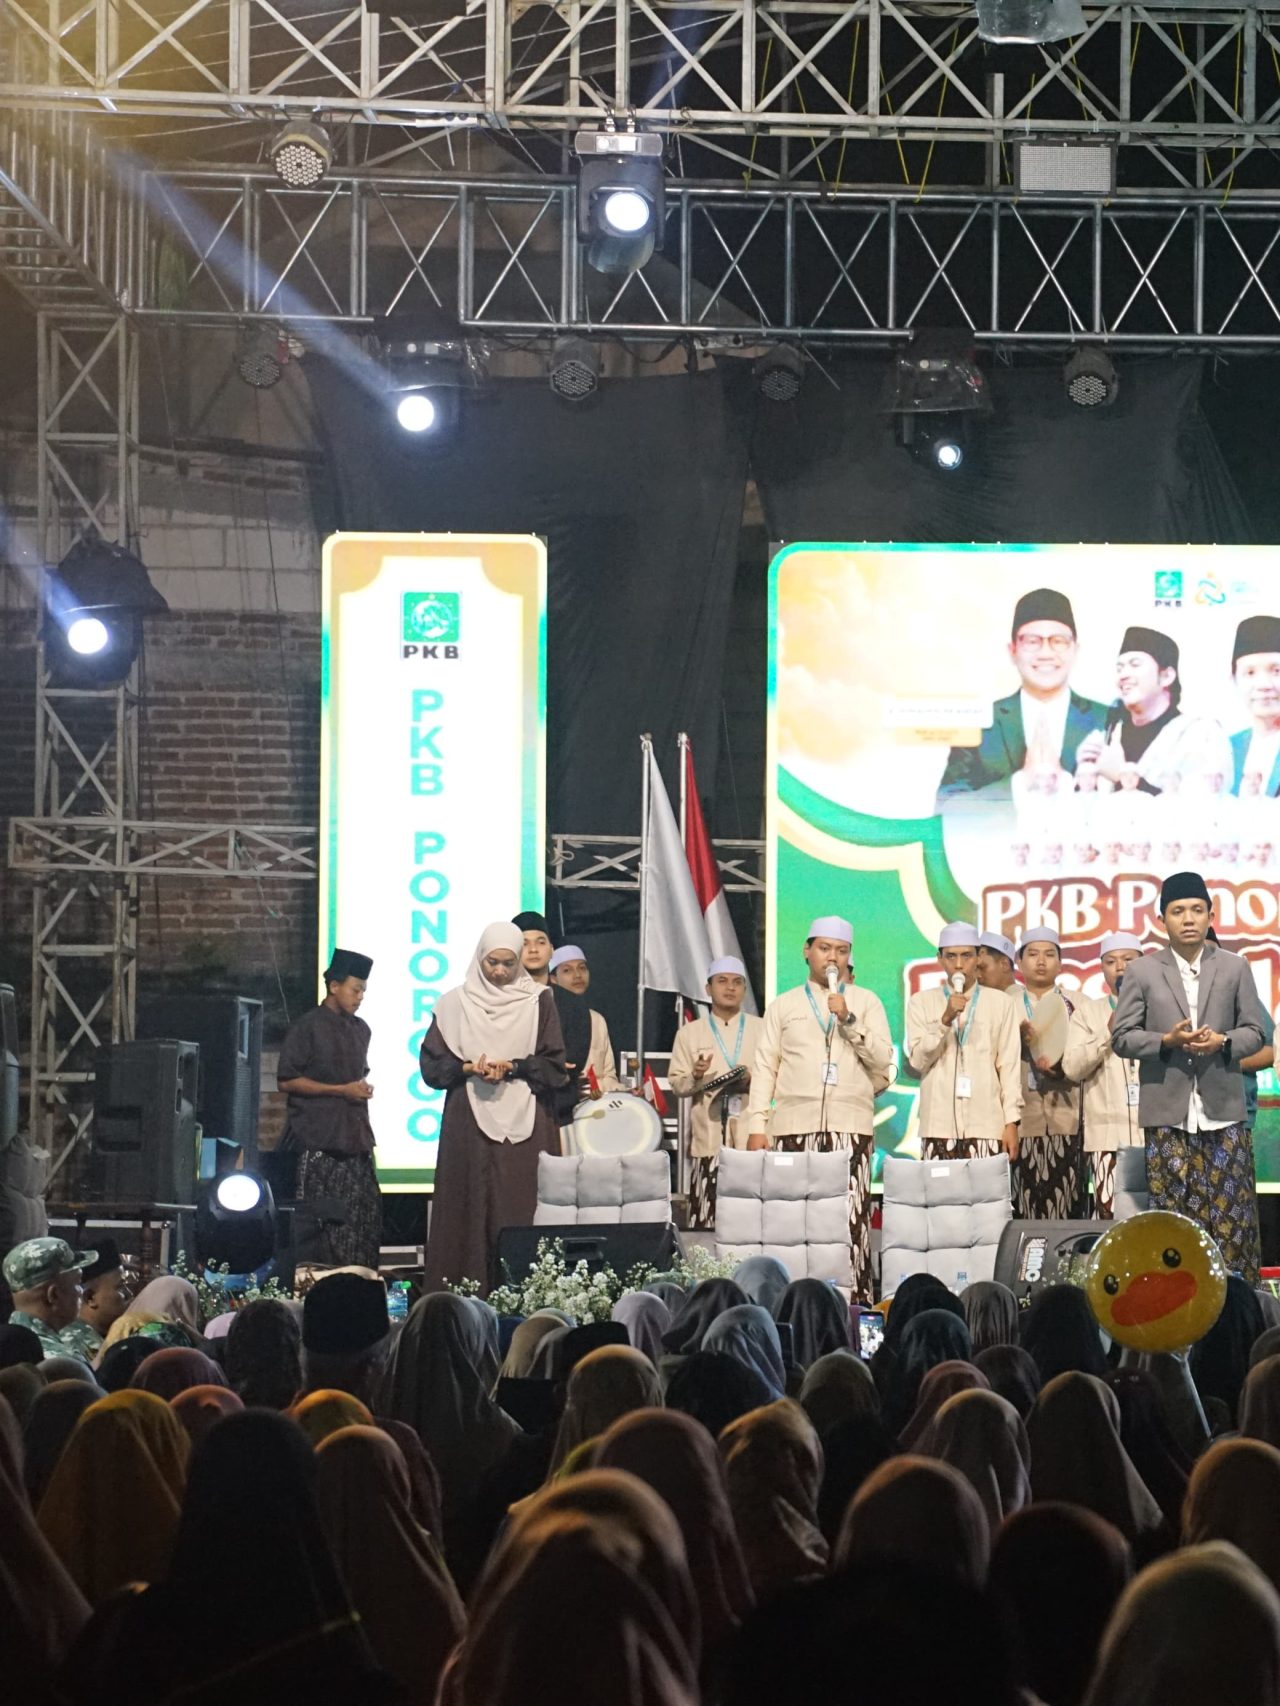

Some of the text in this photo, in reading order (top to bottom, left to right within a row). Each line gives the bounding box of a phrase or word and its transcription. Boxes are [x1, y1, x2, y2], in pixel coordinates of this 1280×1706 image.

[403, 645, 459, 659] PKB
[411, 689, 443, 795] PKB
[985, 883, 1101, 936] PKB
